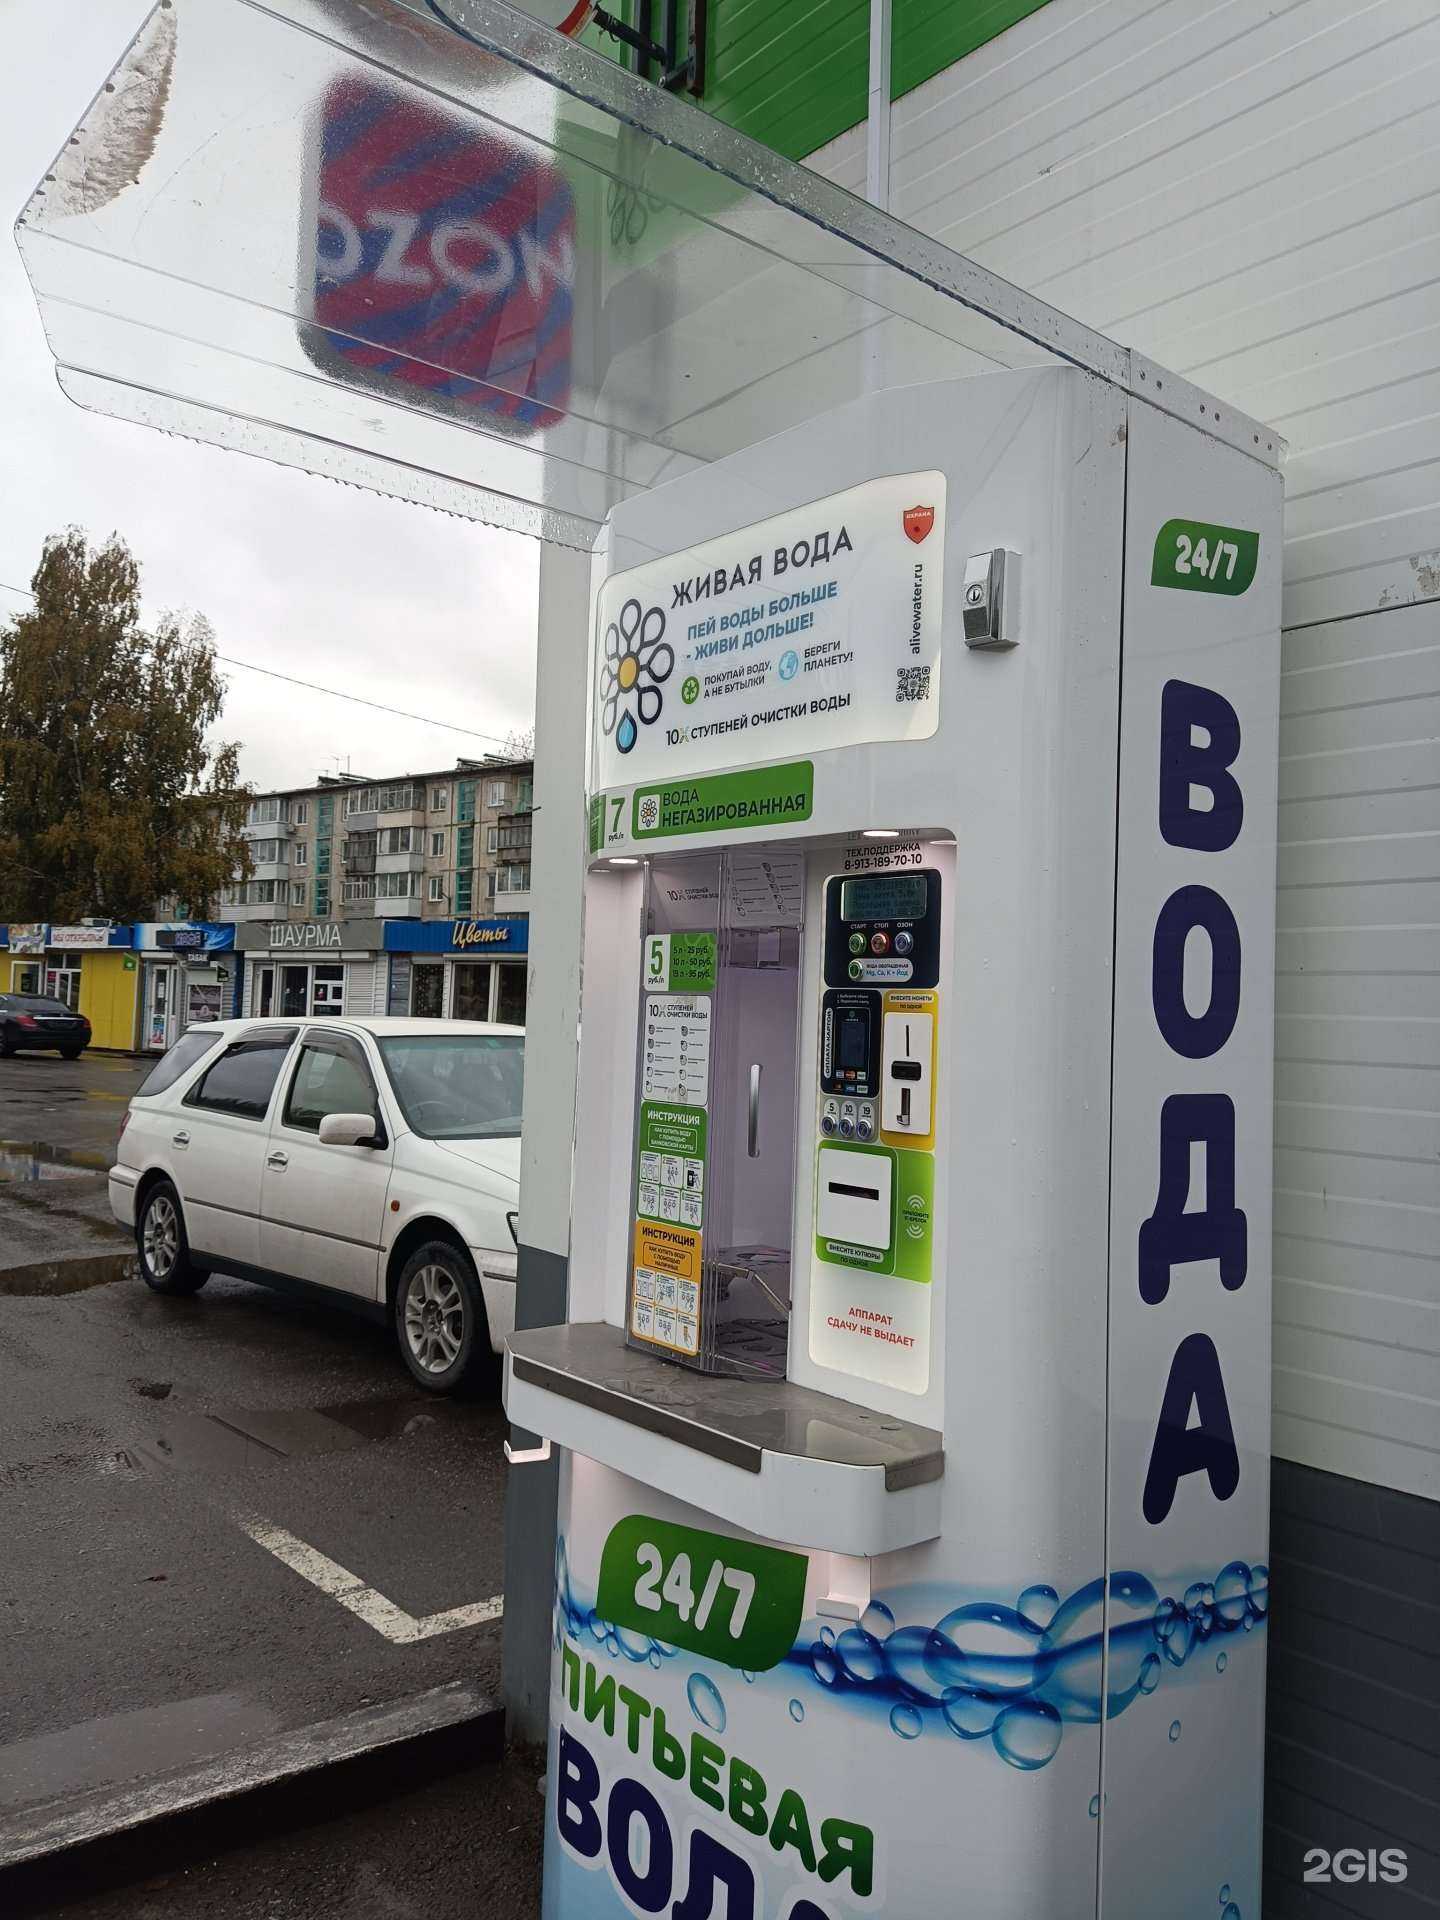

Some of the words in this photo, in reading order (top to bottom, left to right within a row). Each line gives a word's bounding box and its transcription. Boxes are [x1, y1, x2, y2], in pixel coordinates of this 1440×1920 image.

[671, 555, 763, 609] ЖИВАЯ
[773, 525, 853, 576] ВОДА
[1174, 534, 1239, 581] 24/7
[688, 615, 716, 640] ПЕЙ
[720, 604, 764, 632] ВОДЫ
[768, 581, 838, 617] БОЛЬШЕ
[910, 563, 923, 655] alivewater.ru
[695, 635, 738, 661] ЖИВИ
[742, 611, 814, 650] ДОЛЬШЕ!
[804, 640, 841, 658] БЕРЕГИ
[704, 667, 745, 686] ПОКУПАЙ
[746, 661, 772, 676] ВОДУ,
[803, 652, 854, 672] ПЛАНЕТУ!
[704, 688, 711, 698] А
[712, 685, 723, 697] НЕ
[724, 675, 765, 693] БУТЫЛКИ
[690, 715, 748, 740] СТУПЕНЕЙ
[751, 703, 807, 727] ОЧИСТКИ
[810, 693, 851, 714] ВОДЫ
[662, 793, 806, 828] НЕГАЗИРОВАННАЯ
[663, 789, 700, 807] ВОДА
[610, 798, 626, 832] 7
[844, 853, 922, 870] 8-913-189-70-10
[847, 842, 921, 858] ТЕХ.ПОДДЕРЖКА
[270, 924, 342, 947] ШАУРМА
[452, 920, 509, 949] Цветы
[650, 940, 663, 975] 5
[647, 1109, 700, 1125] ИНСТРУКЦИЯ
[845, 1104, 853, 1113] 10
[642, 1226, 695, 1248] ИНСТРУКЦИЯ
[848, 1307, 893, 1326] АППАРАТ
[827, 1317, 858, 1331] СДАЧУ
[860, 1325, 872, 1336] НЕ
[874, 1329, 915, 1348] ВЫДАЕТ
[633, 1542, 756, 1640] 24/7
[561, 1639, 874, 1897] ПИТЬЕВАЯ
